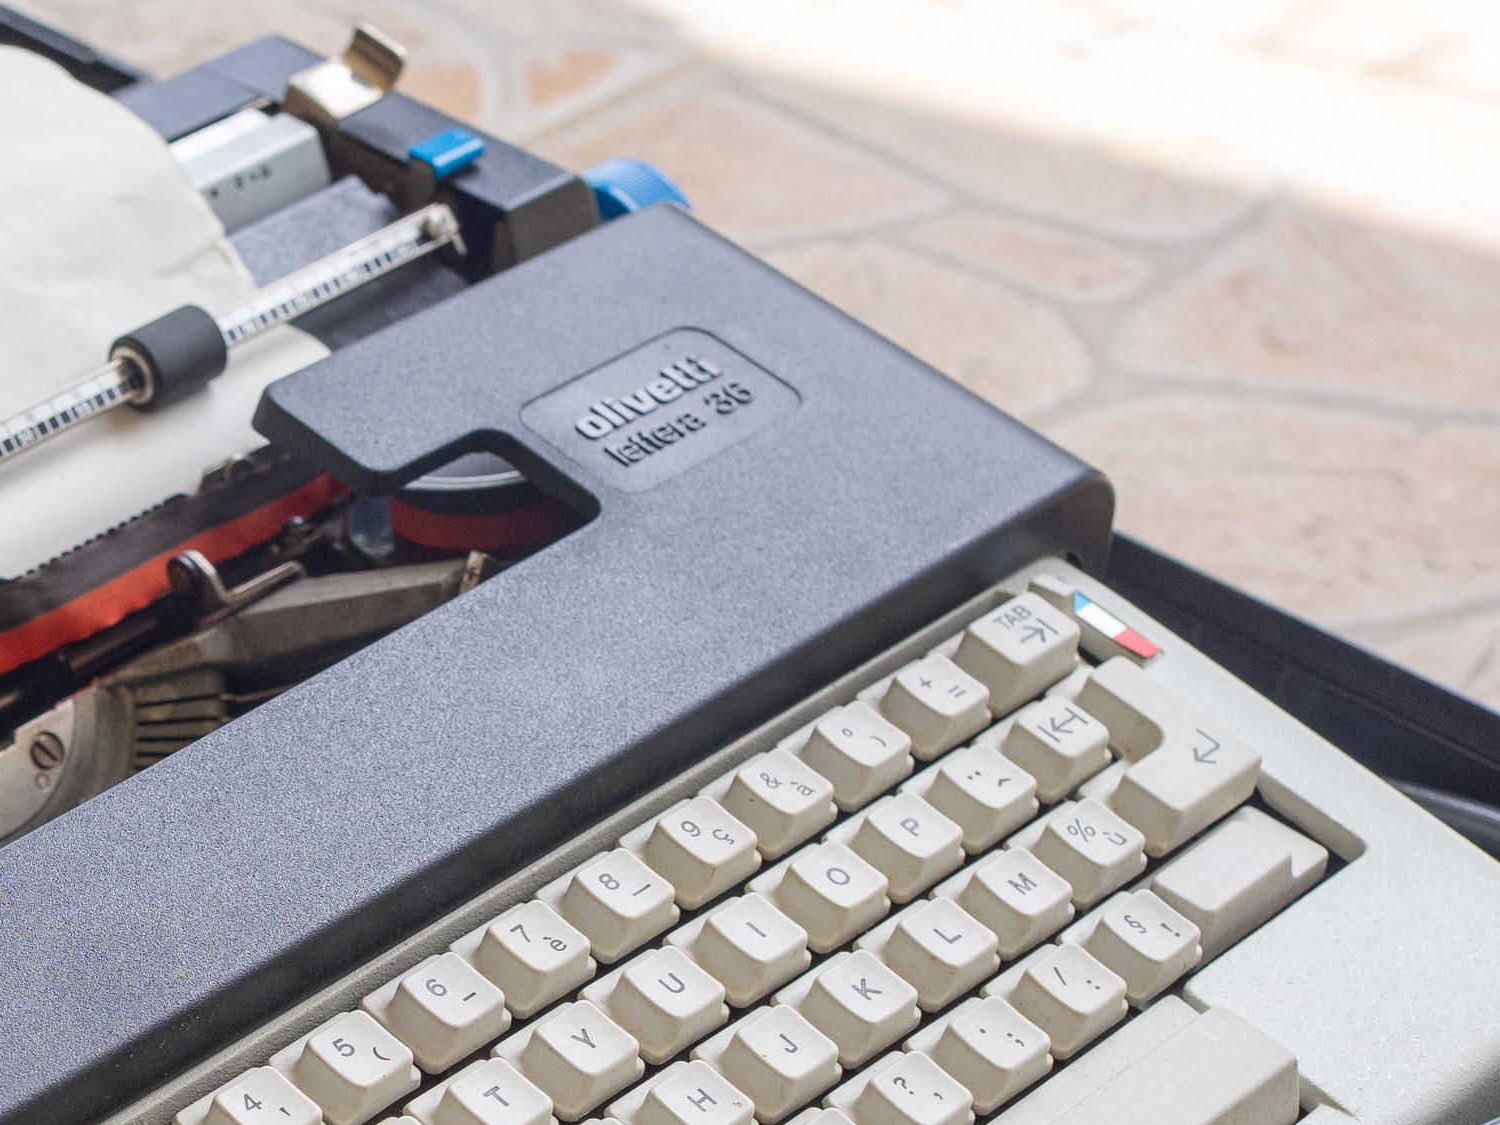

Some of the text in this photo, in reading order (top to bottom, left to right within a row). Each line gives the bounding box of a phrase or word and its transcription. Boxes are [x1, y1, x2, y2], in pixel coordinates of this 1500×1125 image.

[575, 355, 722, 440] olivetti
[603, 382, 756, 467] lettera 36
[993, 605, 1032, 630] TAB
[681, 820, 701, 837] 9
[900, 817, 920, 838] P
[599, 873, 620, 890] 8
[826, 867, 851, 886] O
[1007, 872, 1038, 895] M
[510, 924, 531, 943] 7
[745, 921, 767, 938] I
[932, 928, 963, 945] L
[426, 979, 447, 996] 6
[658, 972, 686, 994] U
[851, 978, 883, 1001] K
[332, 1038, 355, 1058] 5
[570, 1028, 597, 1049] Y
[779, 1033, 798, 1054] J
[243, 1093, 263, 1111] 4
[483, 1085, 510, 1107] T
[686, 1088, 717, 1112] H
